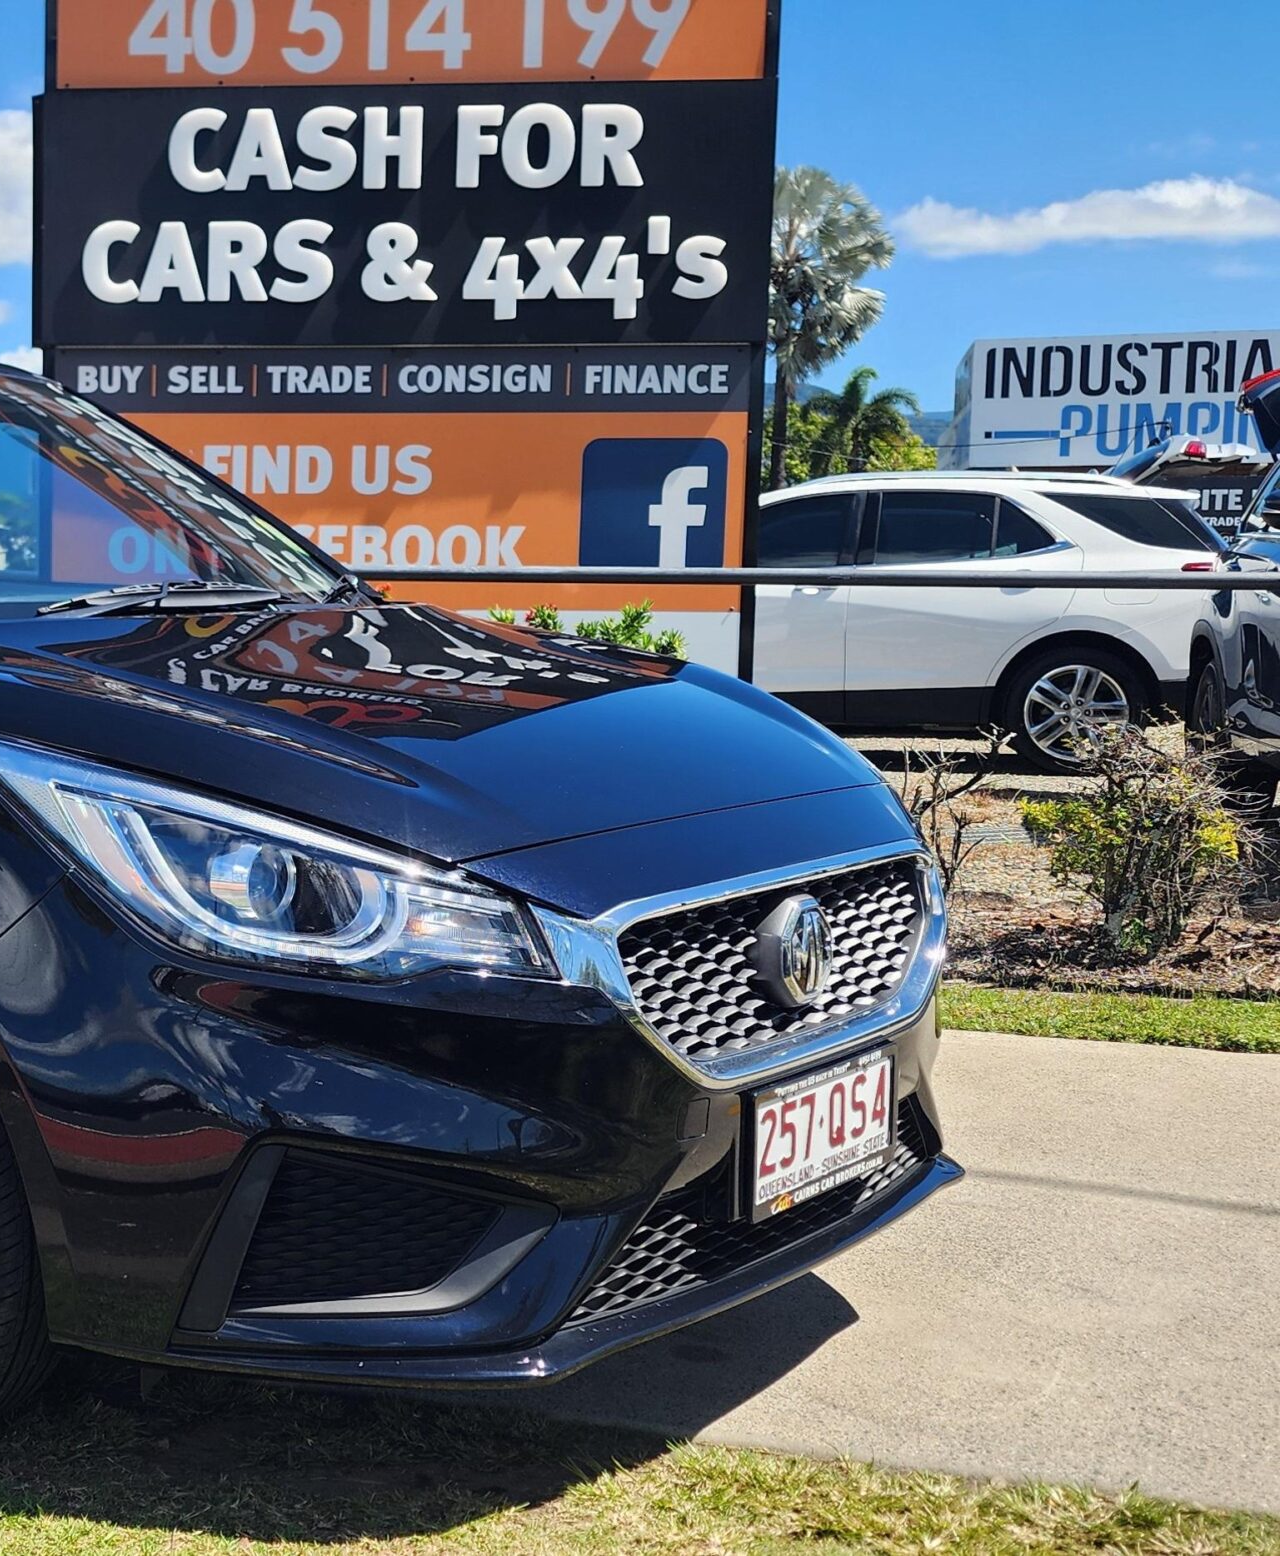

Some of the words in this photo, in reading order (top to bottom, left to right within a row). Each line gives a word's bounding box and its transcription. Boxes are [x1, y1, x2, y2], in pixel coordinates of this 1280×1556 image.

[129, 0, 255, 74] 40
[281, 0, 471, 73] 514
[522, 0, 692, 69] 199
[168, 105, 423, 192] CASH
[455, 103, 645, 189] FOR
[81, 219, 334, 303] CARS
[360, 221, 438, 301] &
[77, 365, 144, 394] BUY
[167, 365, 244, 394] SELL
[267, 365, 372, 394] TRADE
[398, 364, 552, 394] CONSIGN
[585, 364, 729, 394] FINANCE
[985, 339, 1276, 398] INDUSTRIA
[203, 445, 333, 495] FIND
[351, 443, 433, 496] US
[108, 526, 190, 574] ON
[293, 523, 526, 571] EBOOK
[760, 1164, 814, 1199] QUEENSLAND
[822, 1144, 860, 1173] SUNSHINE
[863, 1132, 886, 1156] STATE
[794, 1182, 819, 1203] CAIRNS
[821, 1174, 835, 1191] CAR
